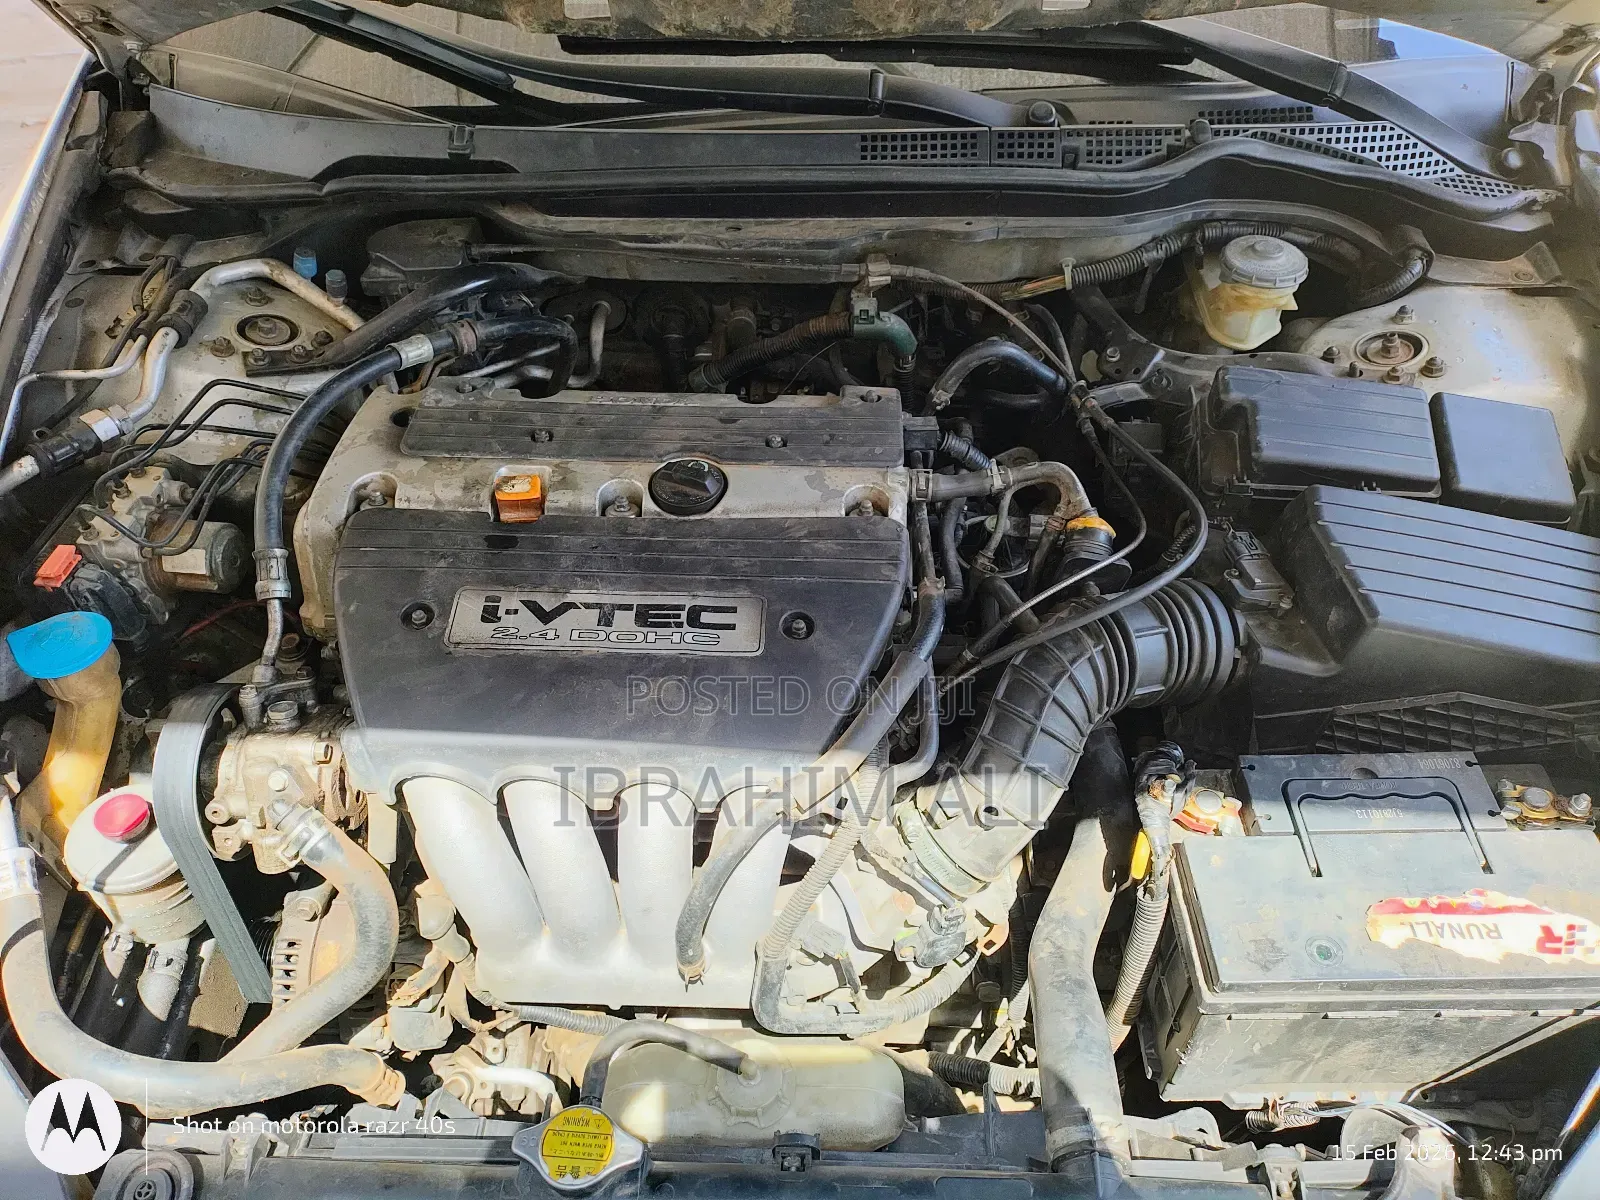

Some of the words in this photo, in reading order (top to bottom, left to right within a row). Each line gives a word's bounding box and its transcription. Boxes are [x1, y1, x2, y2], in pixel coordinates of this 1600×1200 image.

[480, 595, 738, 631] i-VTEC
[490, 626, 560, 641] 2.4
[569, 628, 721, 646] DOHC
[562, 1115, 590, 1128] WARNING
